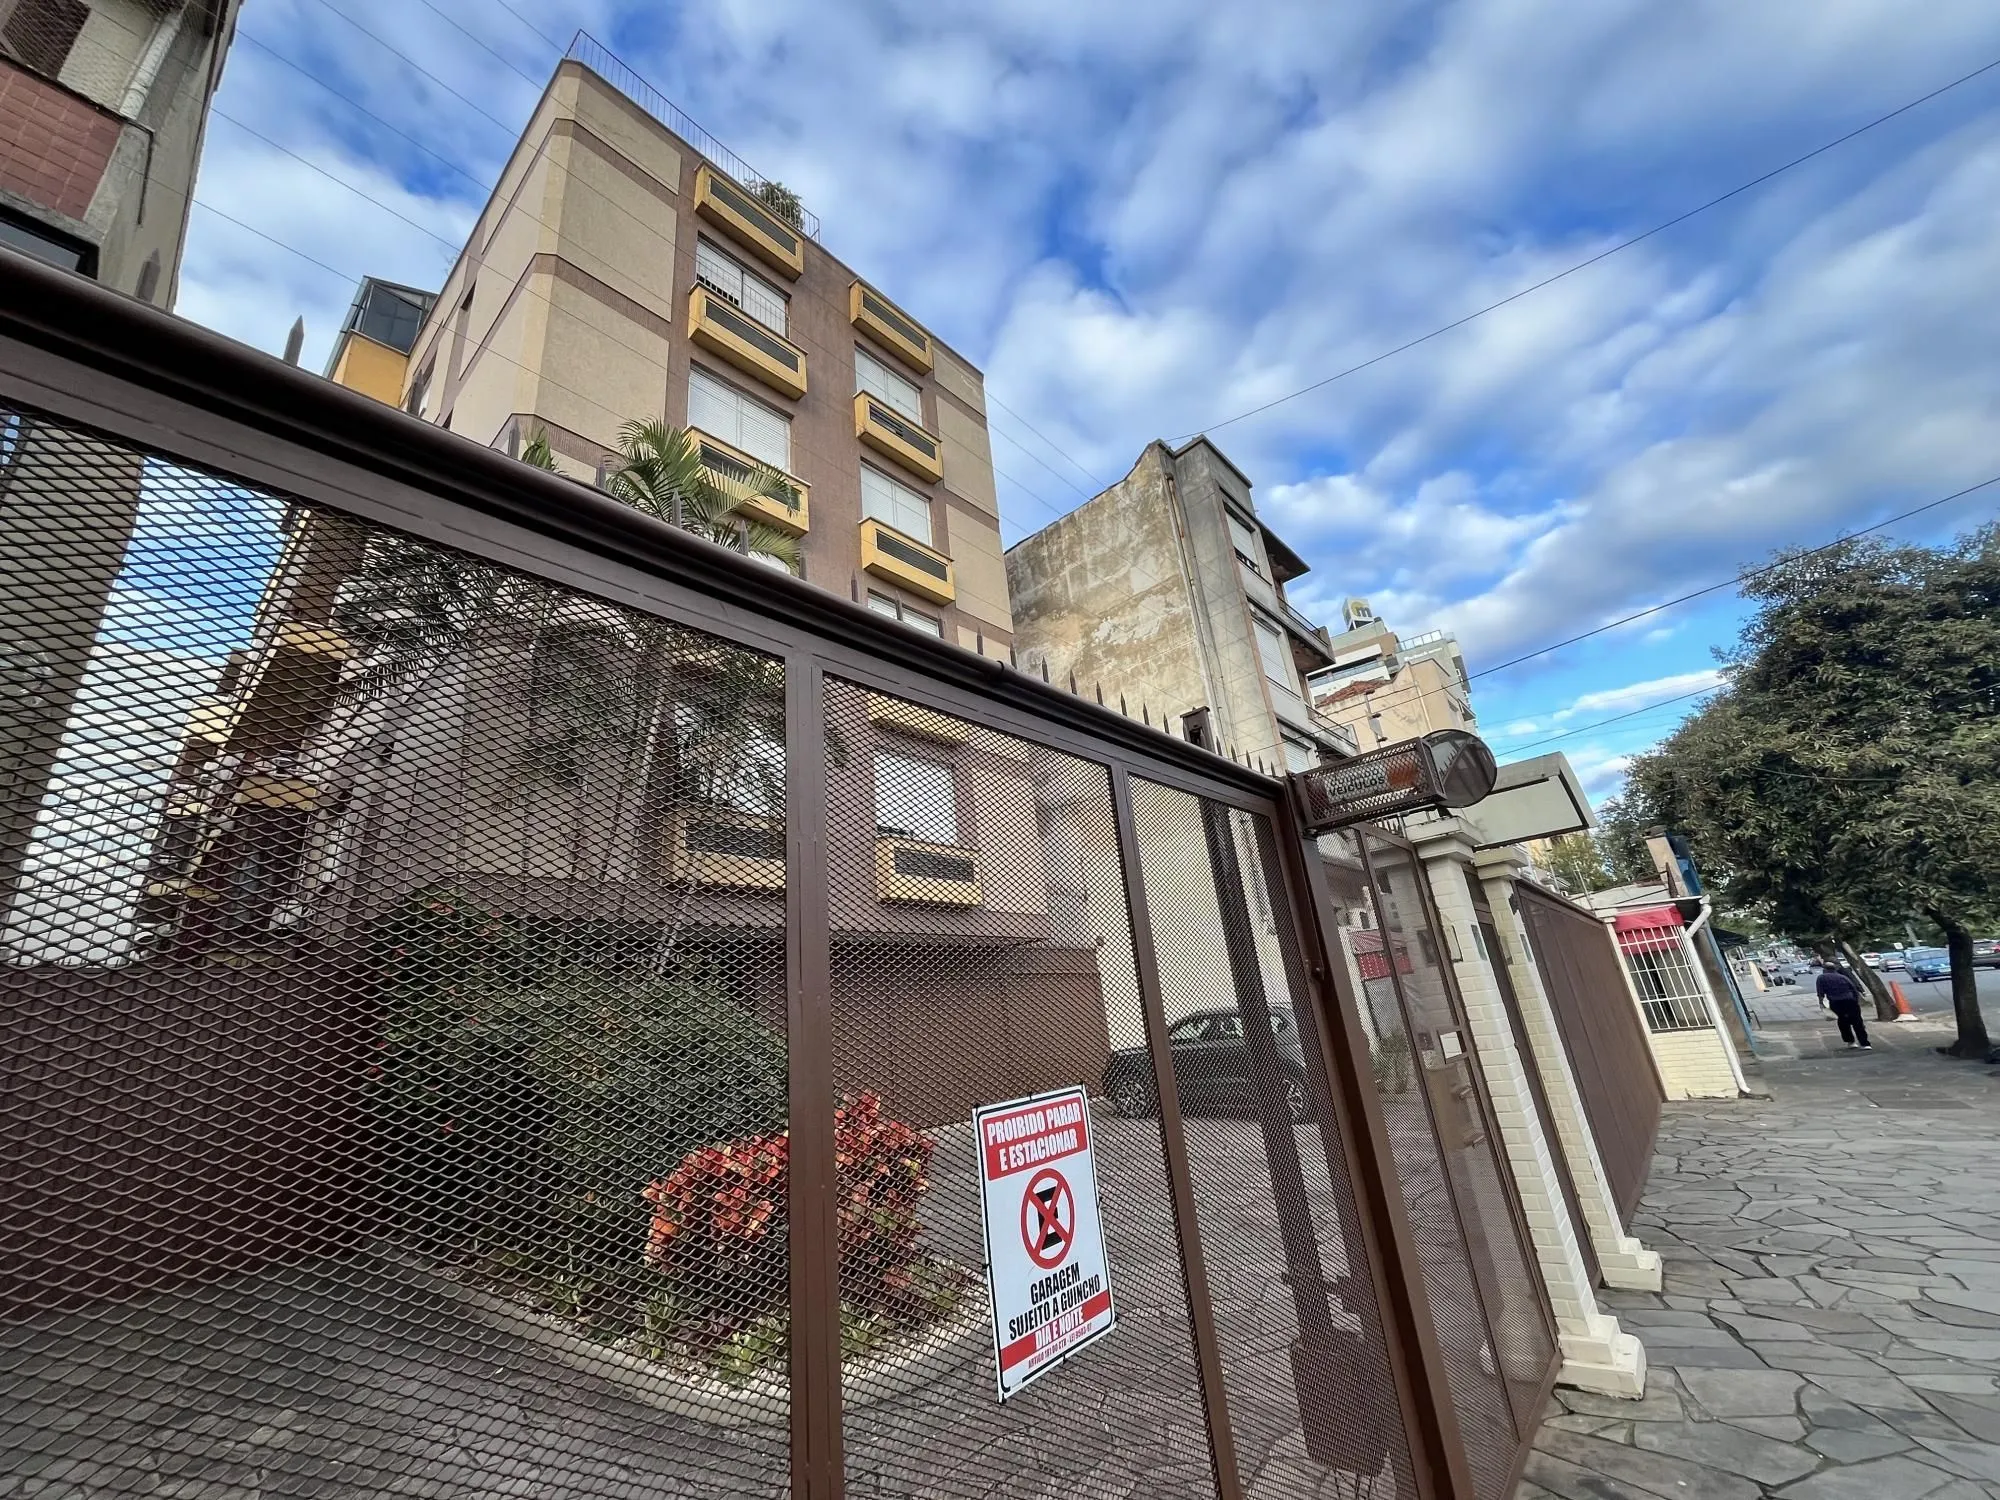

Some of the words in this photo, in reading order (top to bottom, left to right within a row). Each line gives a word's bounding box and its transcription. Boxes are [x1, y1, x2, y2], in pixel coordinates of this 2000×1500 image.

[987, 1111, 1045, 1146] PROIBIDO
[1046, 1102, 1081, 1130] PARAR
[999, 1148, 1008, 1171] E
[1009, 1129, 1078, 1168] ESTACIONAR
[1030, 1261, 1080, 1305] GARAGEM
[1009, 1301, 1050, 1340] SUJEITO
[1052, 1297, 1060, 1318] A
[1061, 1274, 1100, 1312] GUINCHO
[1035, 1324, 1053, 1350] DIA
[1052, 1320, 1059, 1340] E
[1059, 1306, 1084, 1336] NOITE
